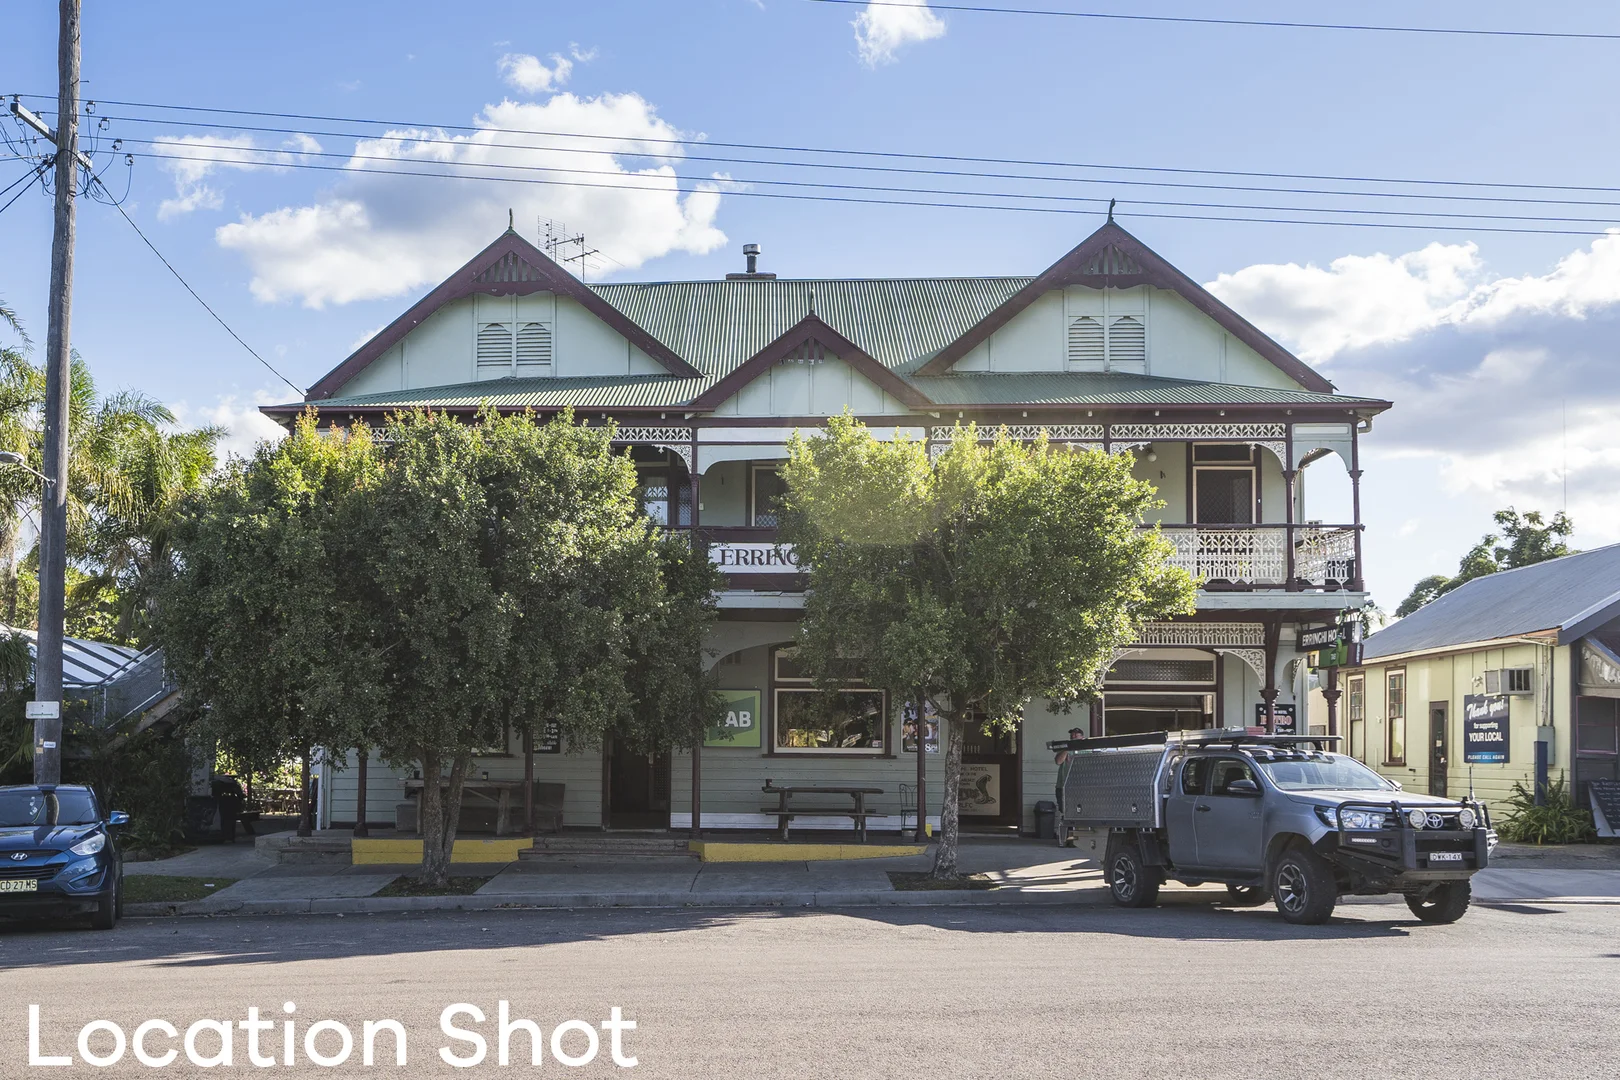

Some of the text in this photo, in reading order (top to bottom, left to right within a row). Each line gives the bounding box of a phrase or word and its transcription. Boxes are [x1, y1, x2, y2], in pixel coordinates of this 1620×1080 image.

[1302, 630, 1328, 646] ERRINGHI
[1328, 627, 1347, 642] HOL
[1466, 699, 1504, 720] Thank you!
[717, 711, 752, 727] AB
[1469, 732, 1504, 742] YOUR LOCAL
[13, 881, 24, 890] 27
[26, 880, 37, 889] MS
